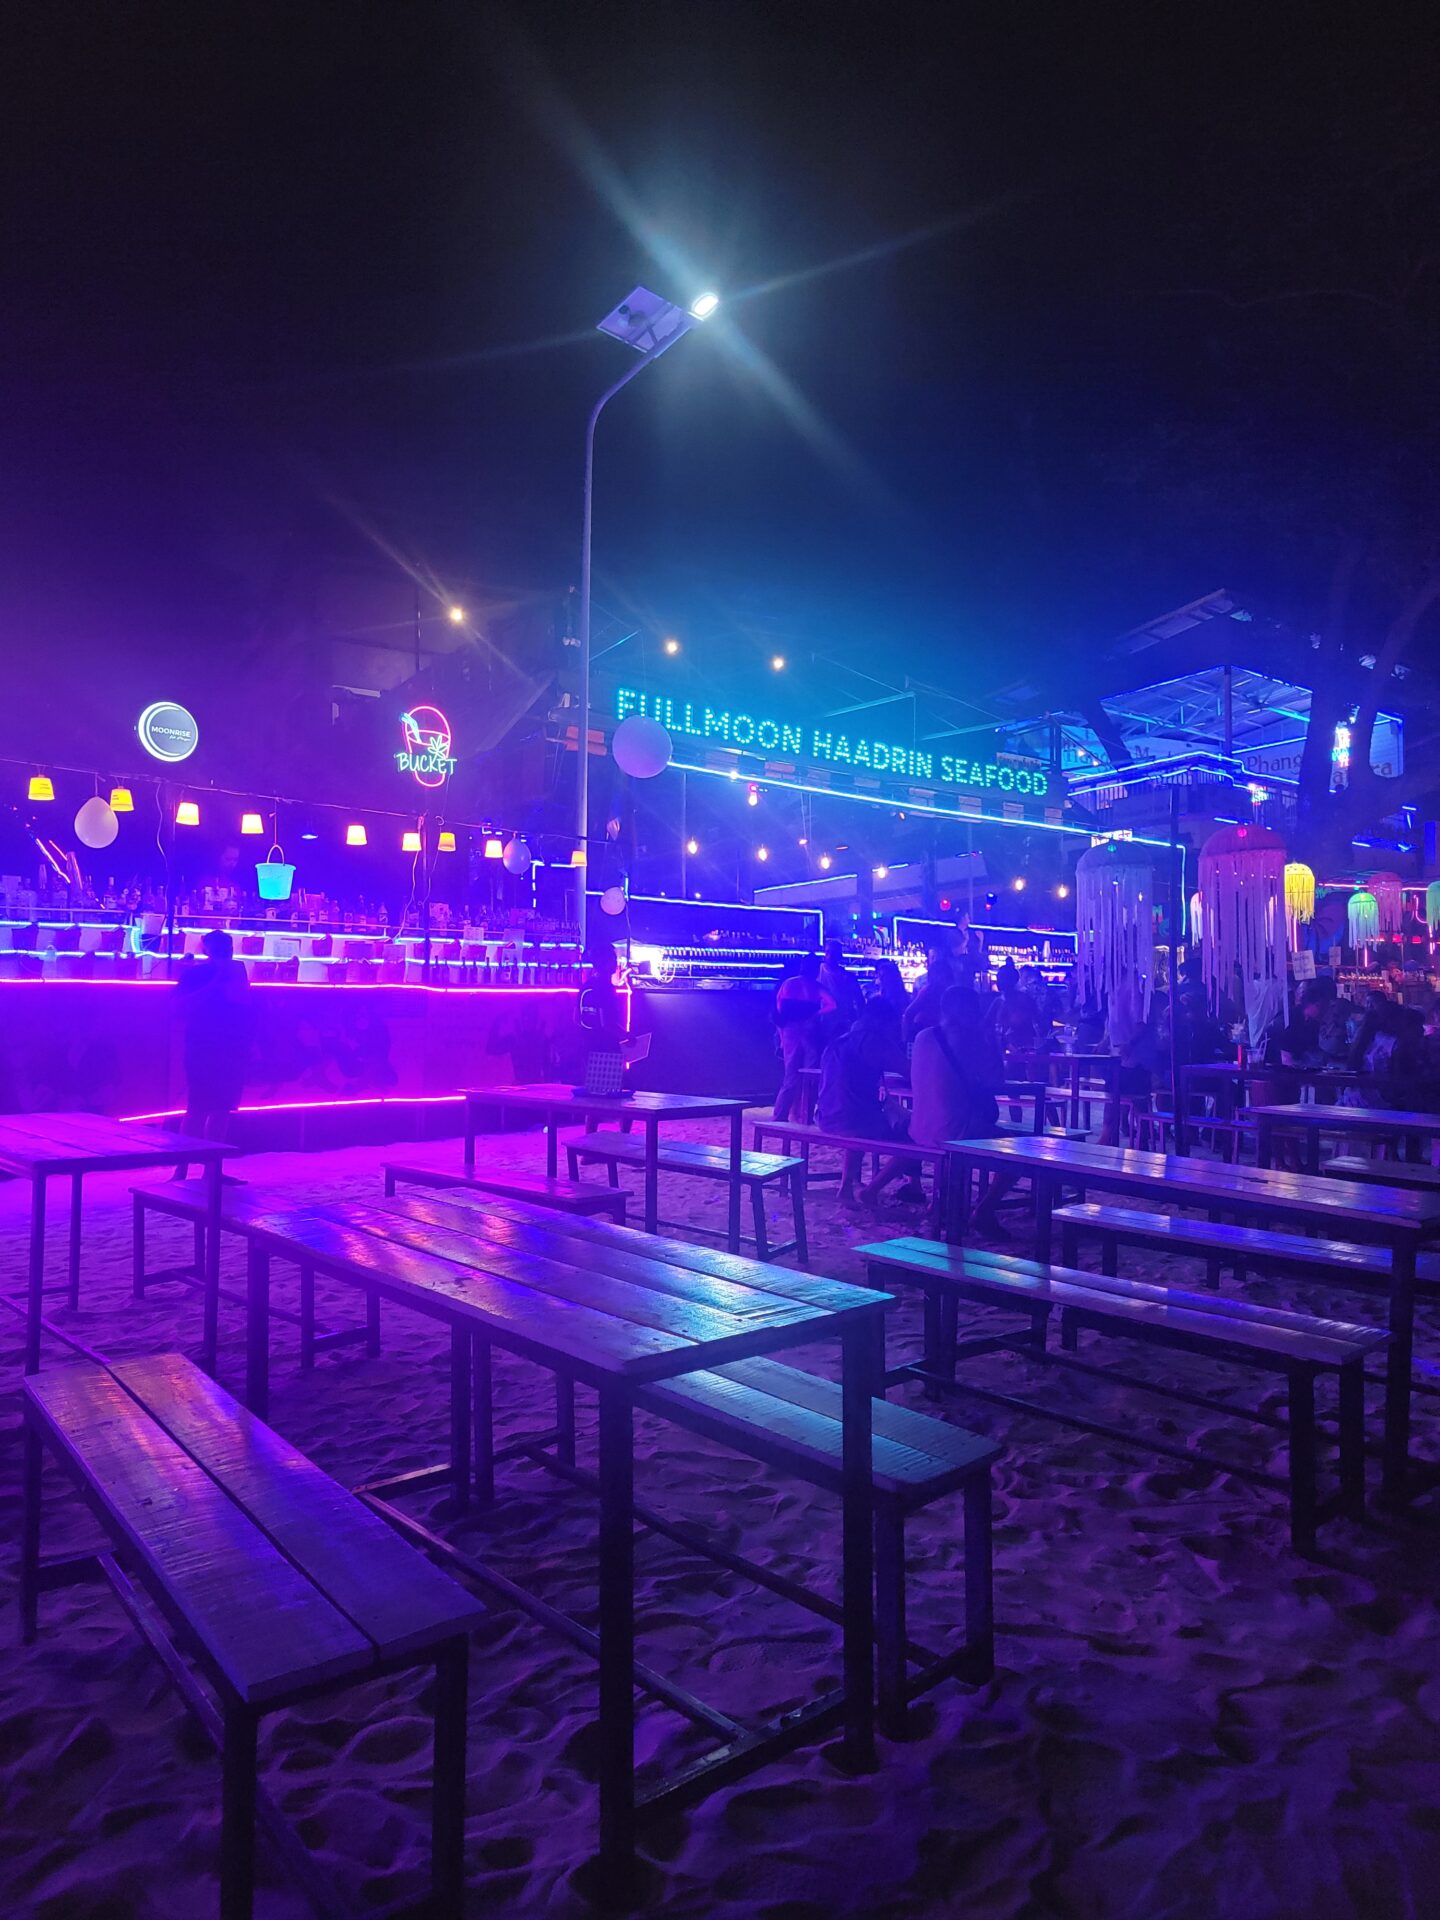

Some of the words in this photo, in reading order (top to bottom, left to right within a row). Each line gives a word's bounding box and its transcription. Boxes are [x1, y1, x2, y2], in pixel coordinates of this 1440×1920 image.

[151, 725, 192, 738] MOONRISE
[396, 752, 458, 776] BUCKET
[812, 729, 933, 779] HAADRIN
[940, 755, 1049, 796] SEAFOOD
